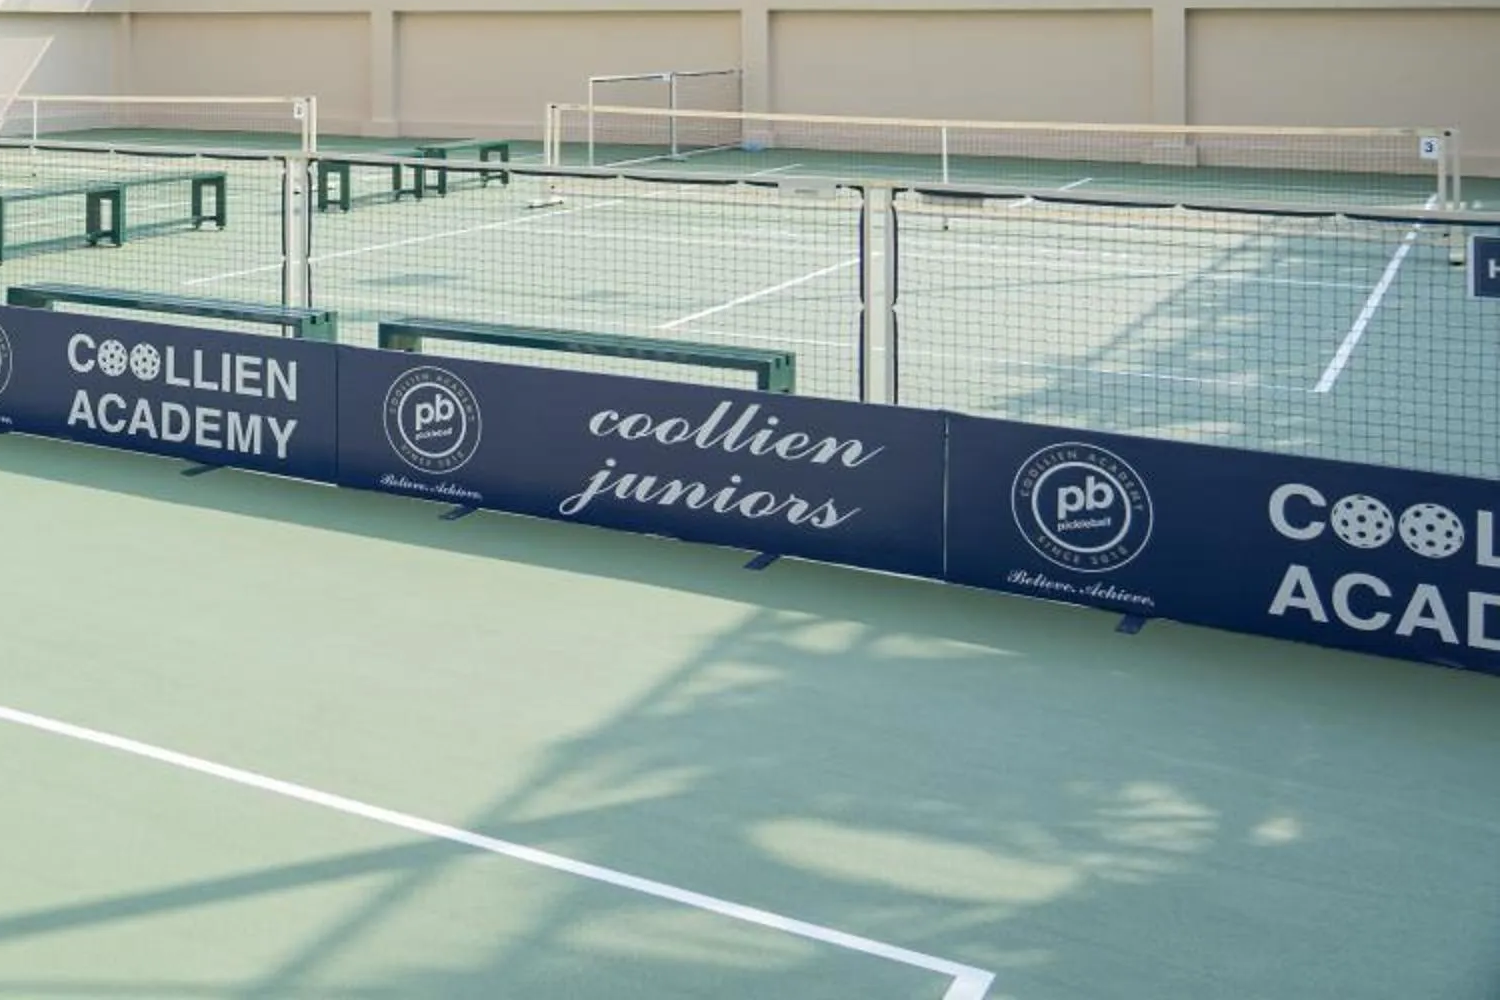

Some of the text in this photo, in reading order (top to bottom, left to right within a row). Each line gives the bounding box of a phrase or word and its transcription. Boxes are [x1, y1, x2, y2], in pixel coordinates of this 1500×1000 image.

[67, 332, 299, 402] COOLLIEN
[67, 389, 299, 460] ACADEMY
[415, 393, 455, 431] pb
[589, 400, 886, 468] coollien
[559, 458, 862, 530] juniors
[1057, 475, 1115, 520] pb
